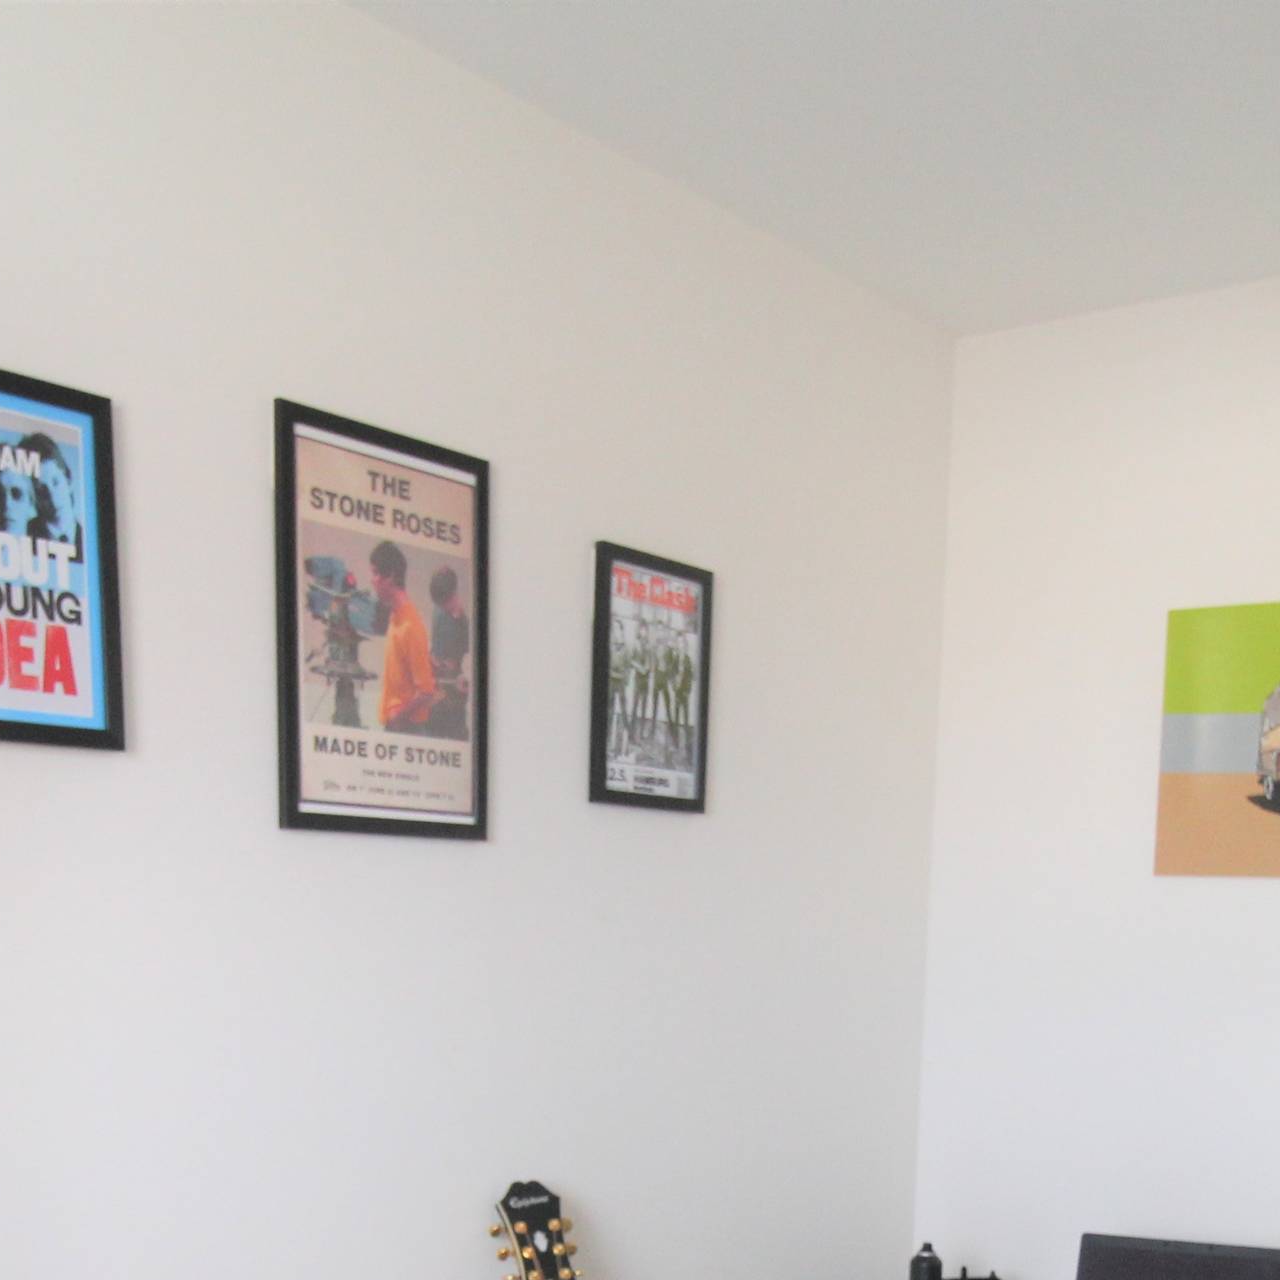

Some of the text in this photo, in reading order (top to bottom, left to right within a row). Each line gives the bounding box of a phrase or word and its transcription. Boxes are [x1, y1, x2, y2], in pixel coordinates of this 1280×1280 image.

[366, 469, 412, 502] THE
[310, 487, 463, 545] STONE ROSES
[612, 567, 647, 600] The
[313, 735, 462, 768] MADE OF STONE
